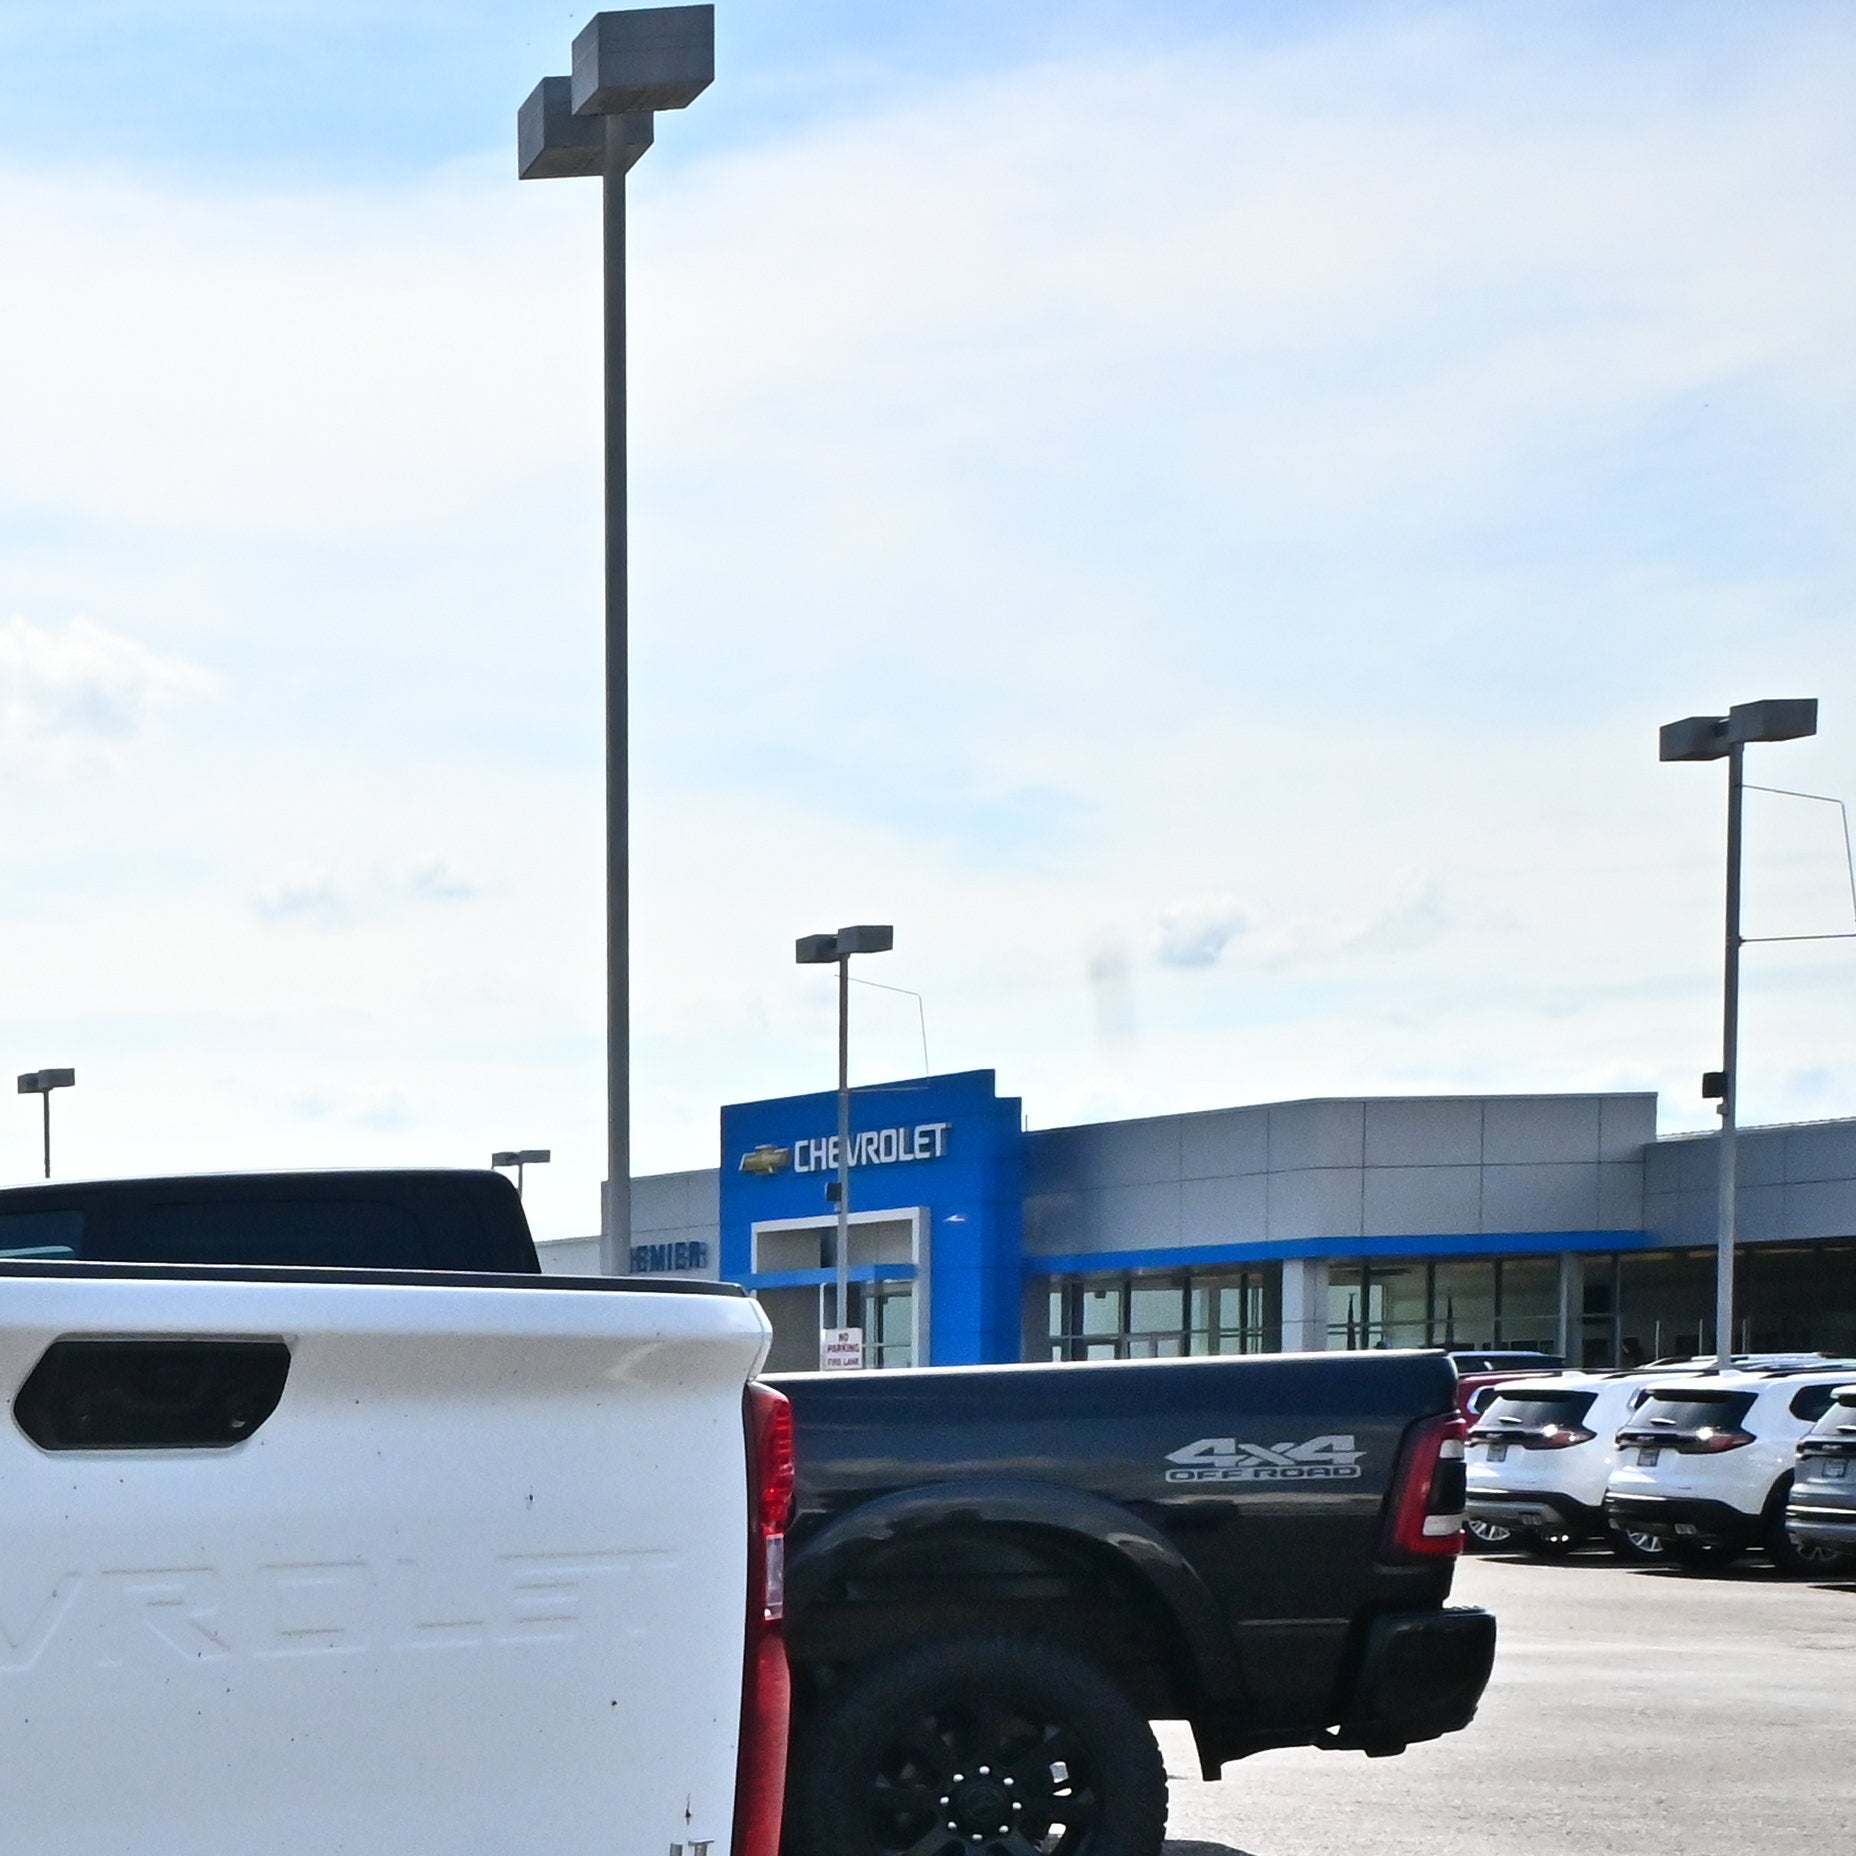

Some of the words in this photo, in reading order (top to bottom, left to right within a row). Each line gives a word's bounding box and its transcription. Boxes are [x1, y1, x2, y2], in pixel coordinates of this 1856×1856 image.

[793, 1121, 952, 1174] CHEVROLET
[630, 1241, 707, 1273] EMIER
[838, 1332, 849, 1342] NO
[827, 1343, 860, 1353] PARKING
[843, 1357, 860, 1366] LANE
[1168, 1467, 1245, 1481] OFF
[1253, 1465, 1358, 1479] ROAD
